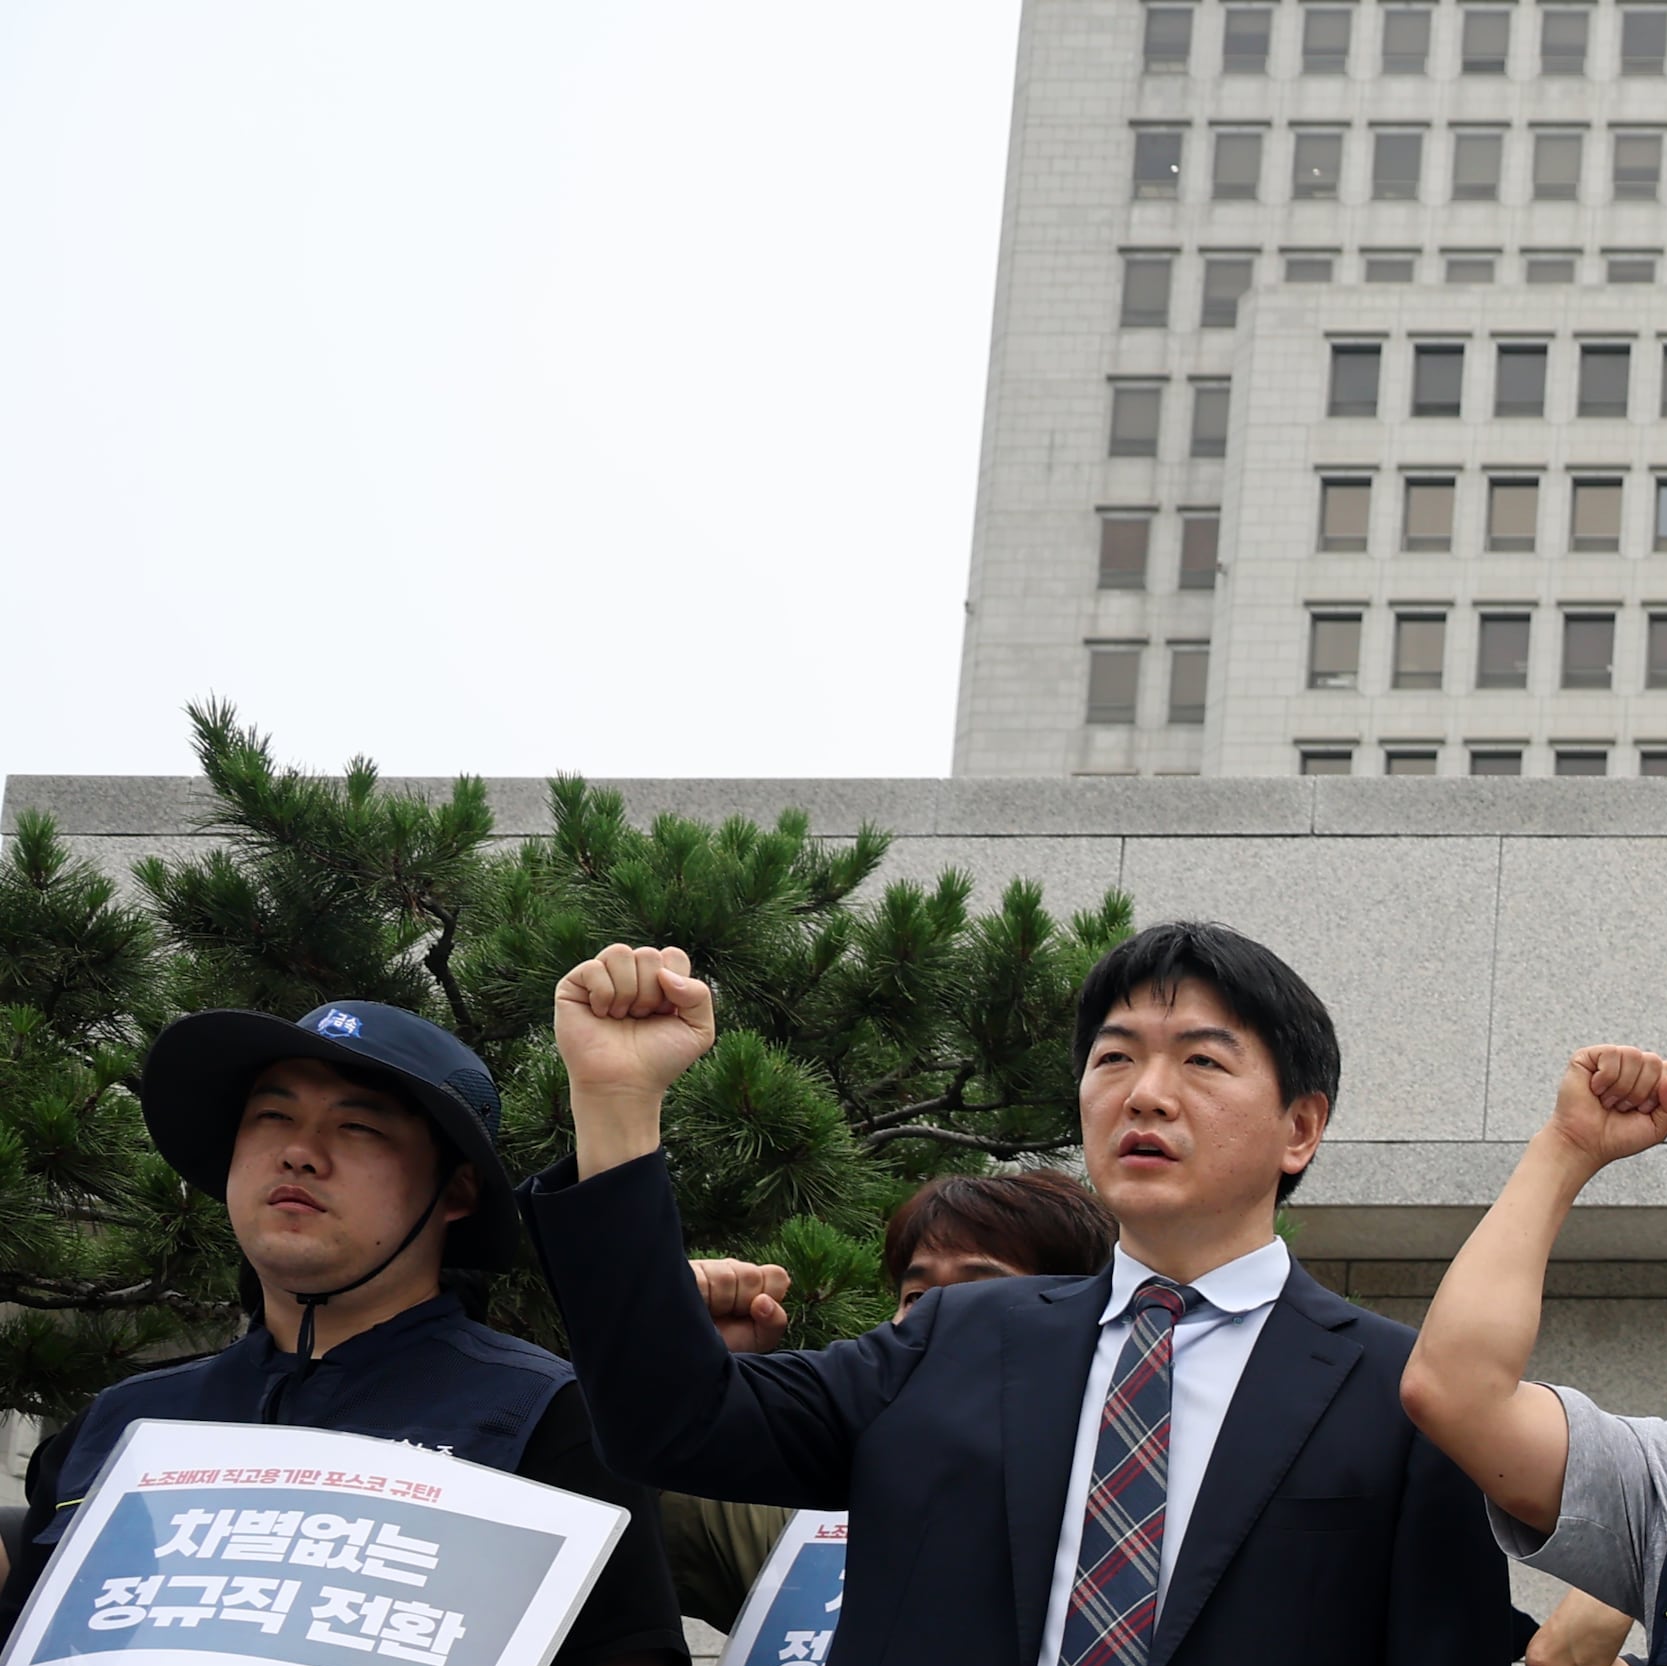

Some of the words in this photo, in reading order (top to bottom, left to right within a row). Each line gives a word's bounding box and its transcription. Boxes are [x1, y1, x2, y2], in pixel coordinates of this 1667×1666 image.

[137, 1470, 219, 1487] 노조배제
[222, 1468, 321, 1485] 직고용기만
[322, 1471, 387, 1493] 포스코
[389, 1479, 442, 1503] 규탄!
[154, 1508, 440, 1588] 차별없는
[814, 1524, 848, 1539] 노조
[88, 1575, 302, 1634] 정규직
